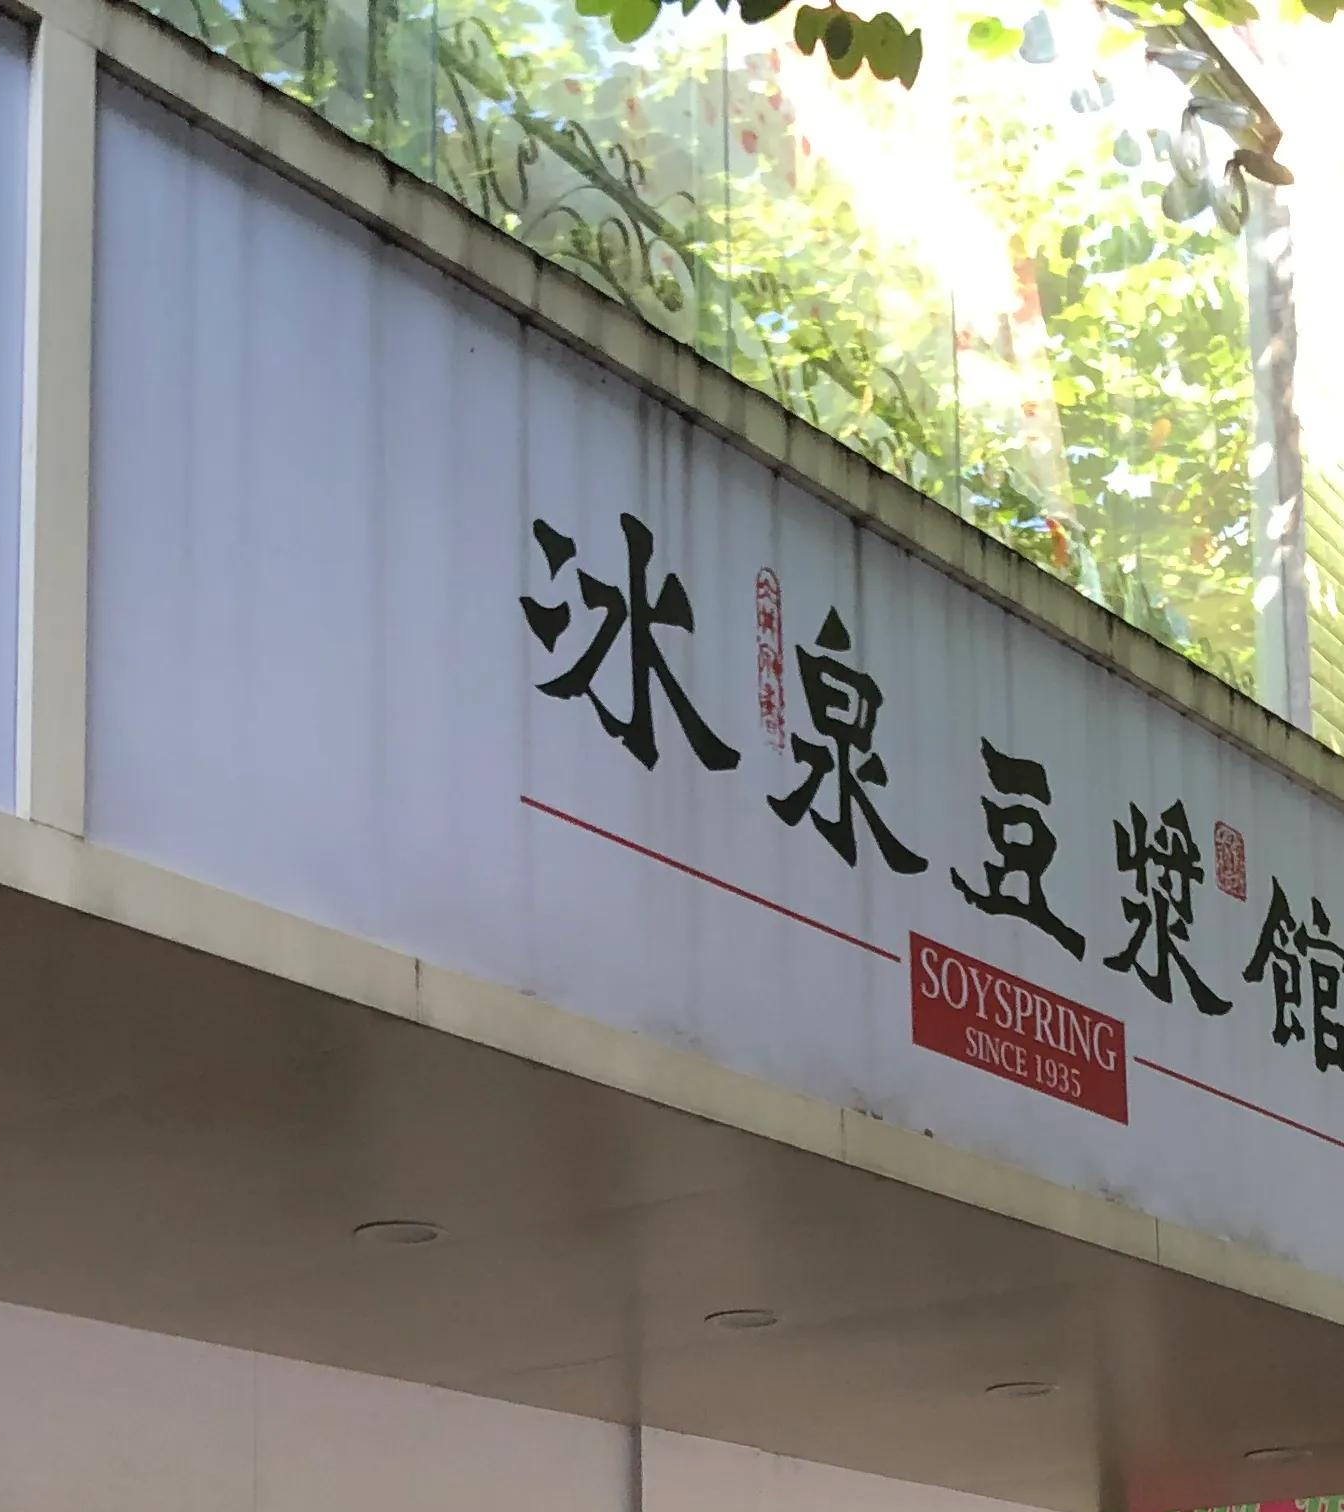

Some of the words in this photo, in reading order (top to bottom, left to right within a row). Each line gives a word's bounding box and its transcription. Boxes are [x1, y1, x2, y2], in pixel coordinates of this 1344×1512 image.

[920, 947, 1117, 1071] SOYSPRING
[965, 1026, 1028, 1077] SINCE
[1035, 1054, 1081, 1098] 1935
